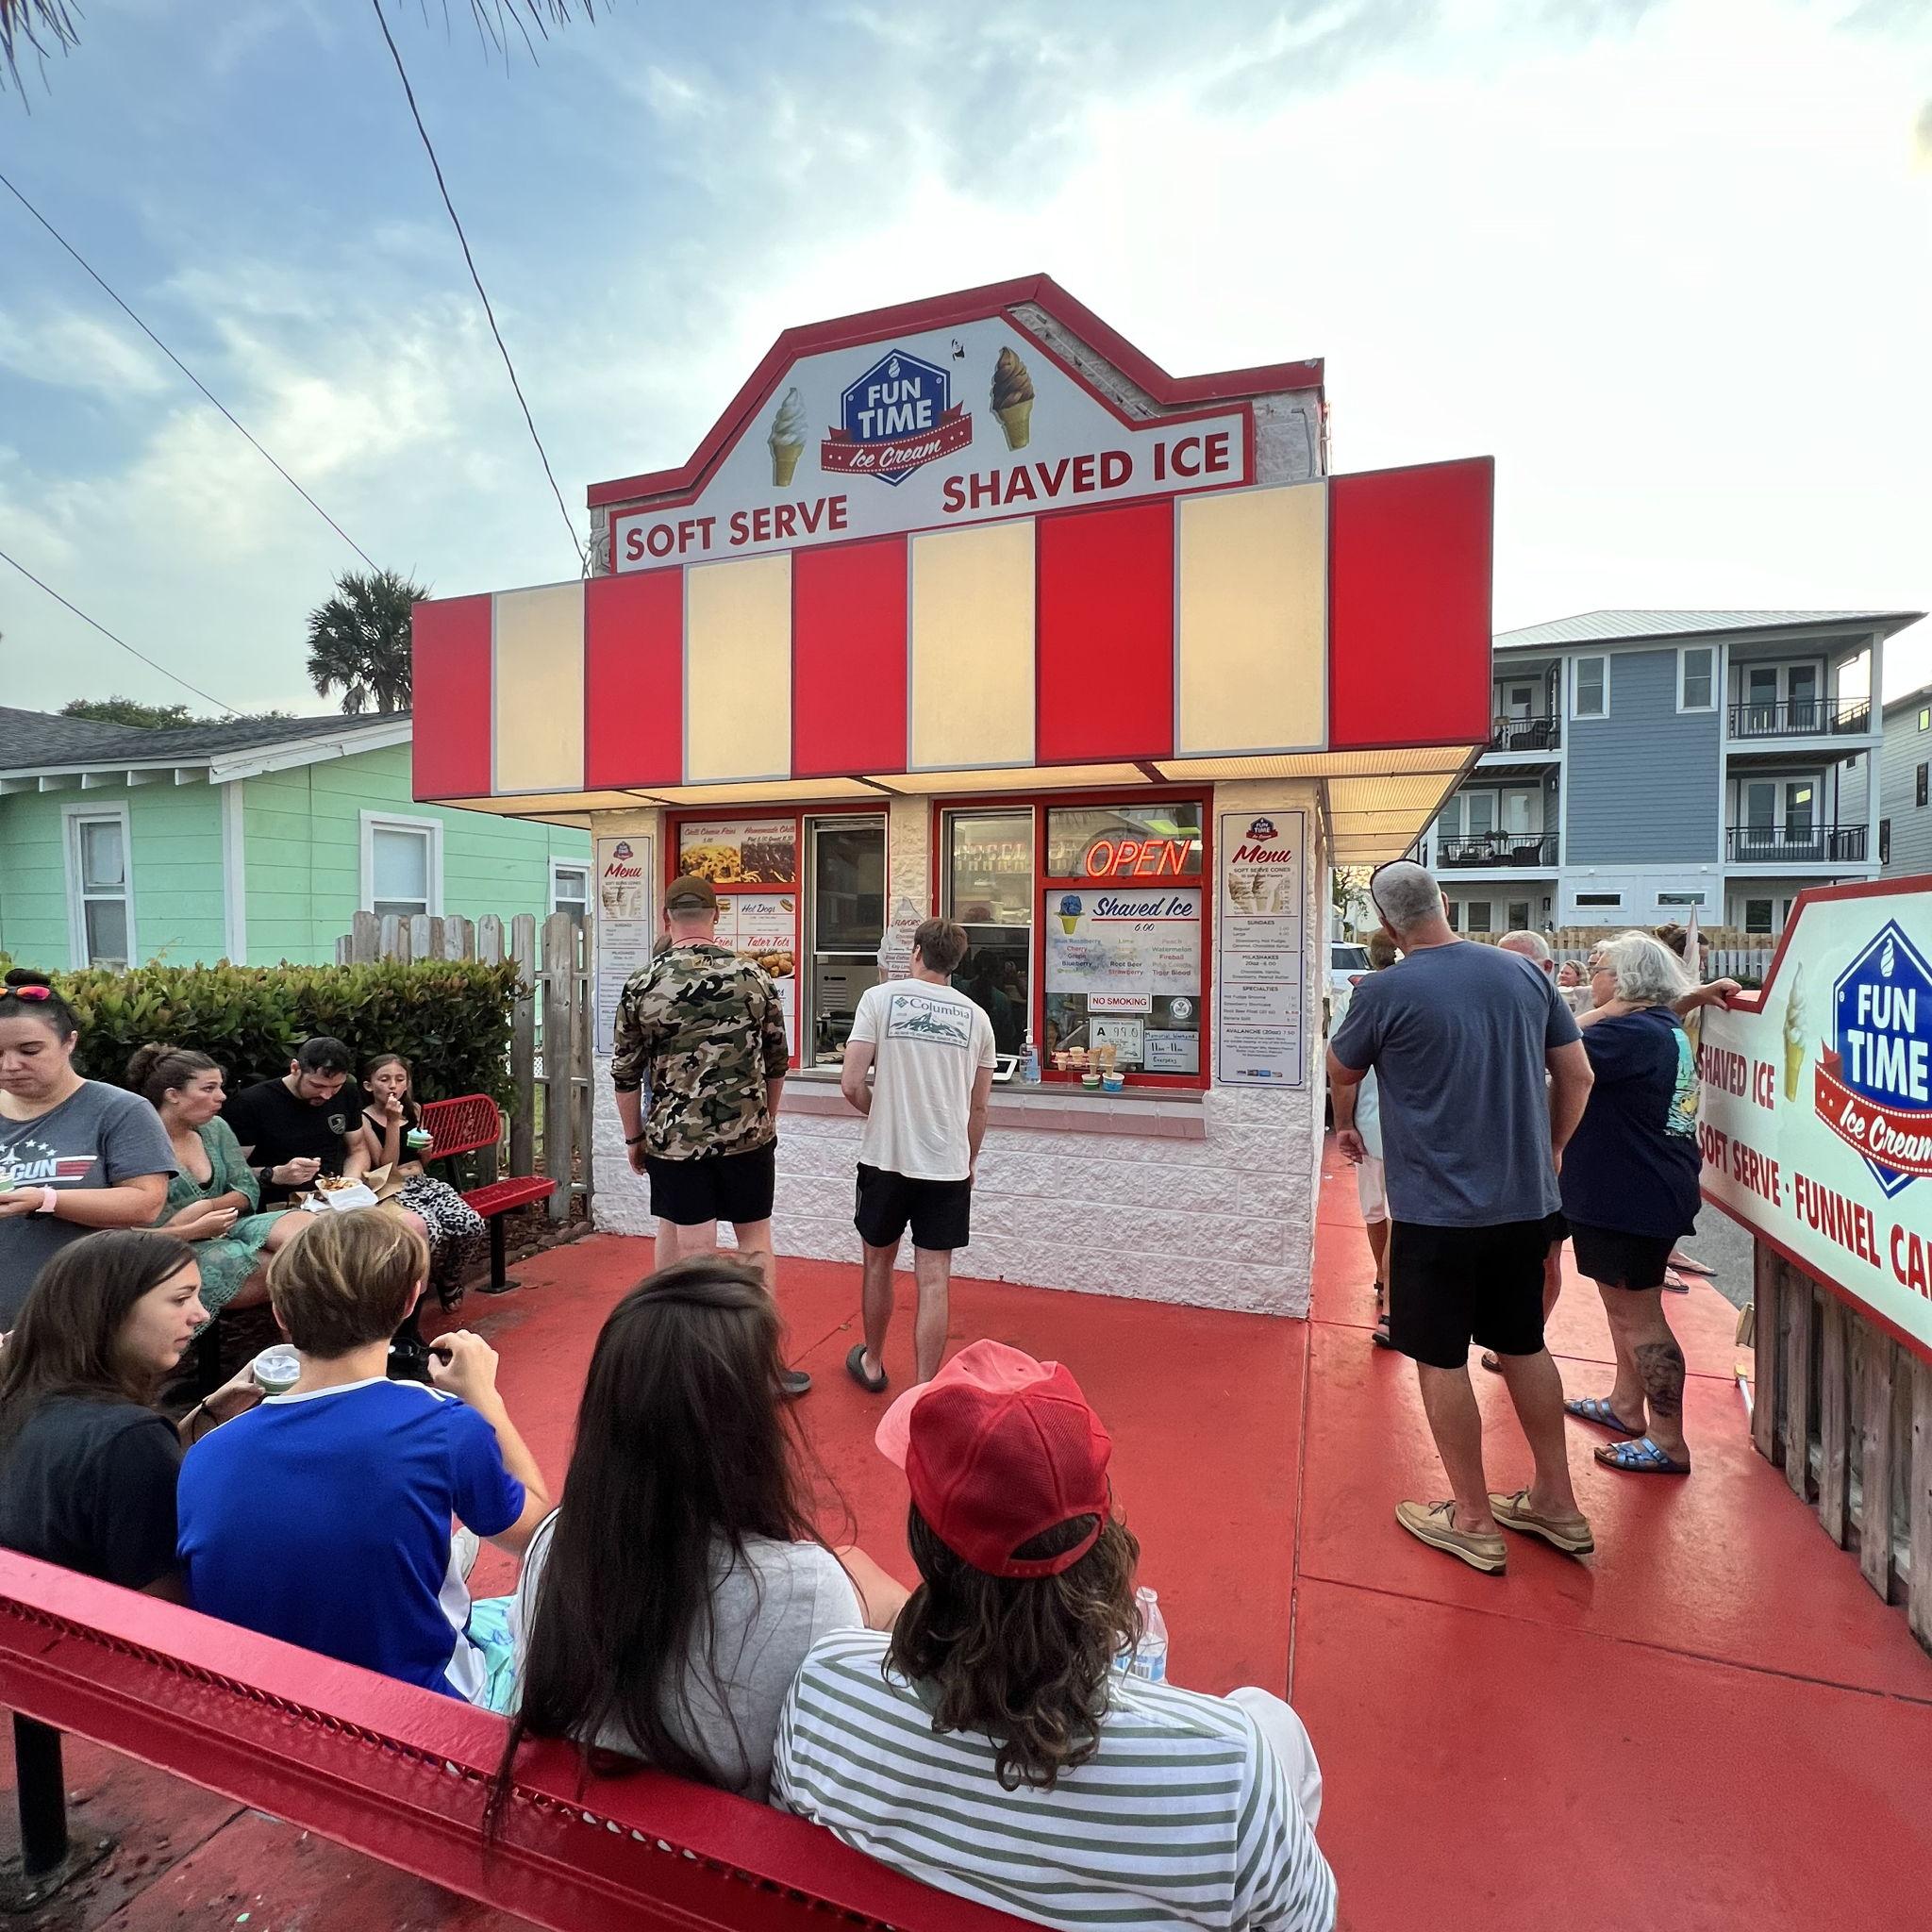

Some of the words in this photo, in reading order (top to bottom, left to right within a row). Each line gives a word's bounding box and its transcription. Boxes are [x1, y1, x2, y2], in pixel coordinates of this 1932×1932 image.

[868, 377, 921, 408] FUN
[858, 399, 932, 439] TIME
[849, 448, 875, 468] Ice
[879, 440, 941, 468] Cream
[942, 450, 1133, 513] SHAVED
[1154, 432, 1229, 481] ICE
[625, 516, 716, 561] SOFT
[729, 494, 848, 545] SERVE
[1086, 839, 1192, 877] OPEN
[1232, 844, 1292, 863] Menu
[604, 862, 642, 878] Menu
[741, 904, 756, 913] Hot
[757, 904, 775, 913] Dogs
[1093, 897, 1165, 917] Shaved
[1166, 897, 1192, 917] Ice
[747, 937, 771, 947] Tater
[773, 937, 790, 947] Tots
[909, 998, 970, 1020] Columbia
[1857, 984, 1916, 1034] FUN
[1097, 1026, 1106, 1036] A
[1697, 1041, 1747, 1097] SHAVED
[1752, 1059, 1775, 1110] ICE
[1847, 1028, 1928, 1102] TIME
[1840, 1099, 1866, 1140] Ice
[10, 1158, 58, 1182] GUN
[1699, 1120, 1728, 1174] SOFT
[1732, 1139, 1782, 1208] SERVE
[1794, 1171, 1882, 1270] FUNNEL
[1890, 1224, 1932, 1301] CA
